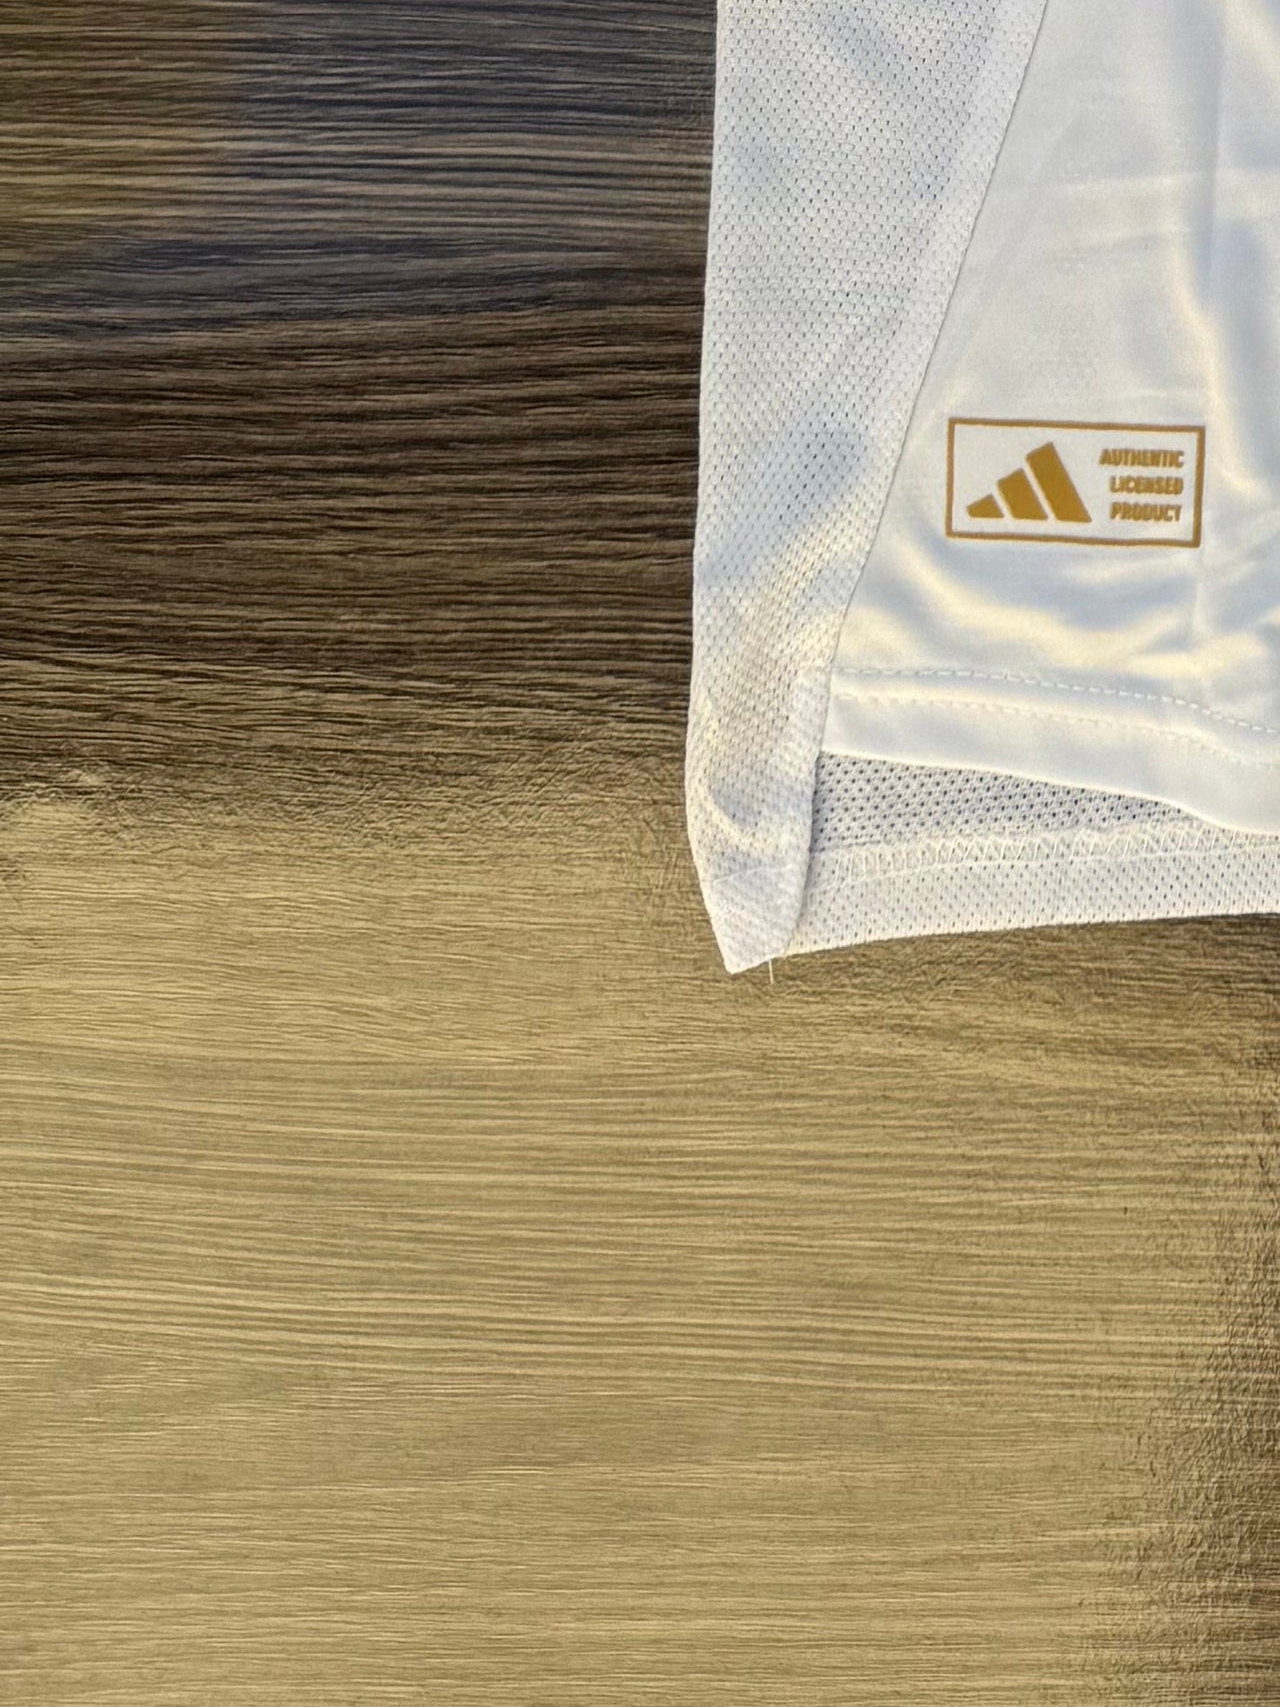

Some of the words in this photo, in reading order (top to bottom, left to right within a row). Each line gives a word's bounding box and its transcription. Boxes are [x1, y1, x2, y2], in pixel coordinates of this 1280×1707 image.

[1099, 448, 1184, 468] AUTHENTIC
[1109, 476, 1184, 495] LICENSED
[1110, 502, 1182, 522] PRODUCT
